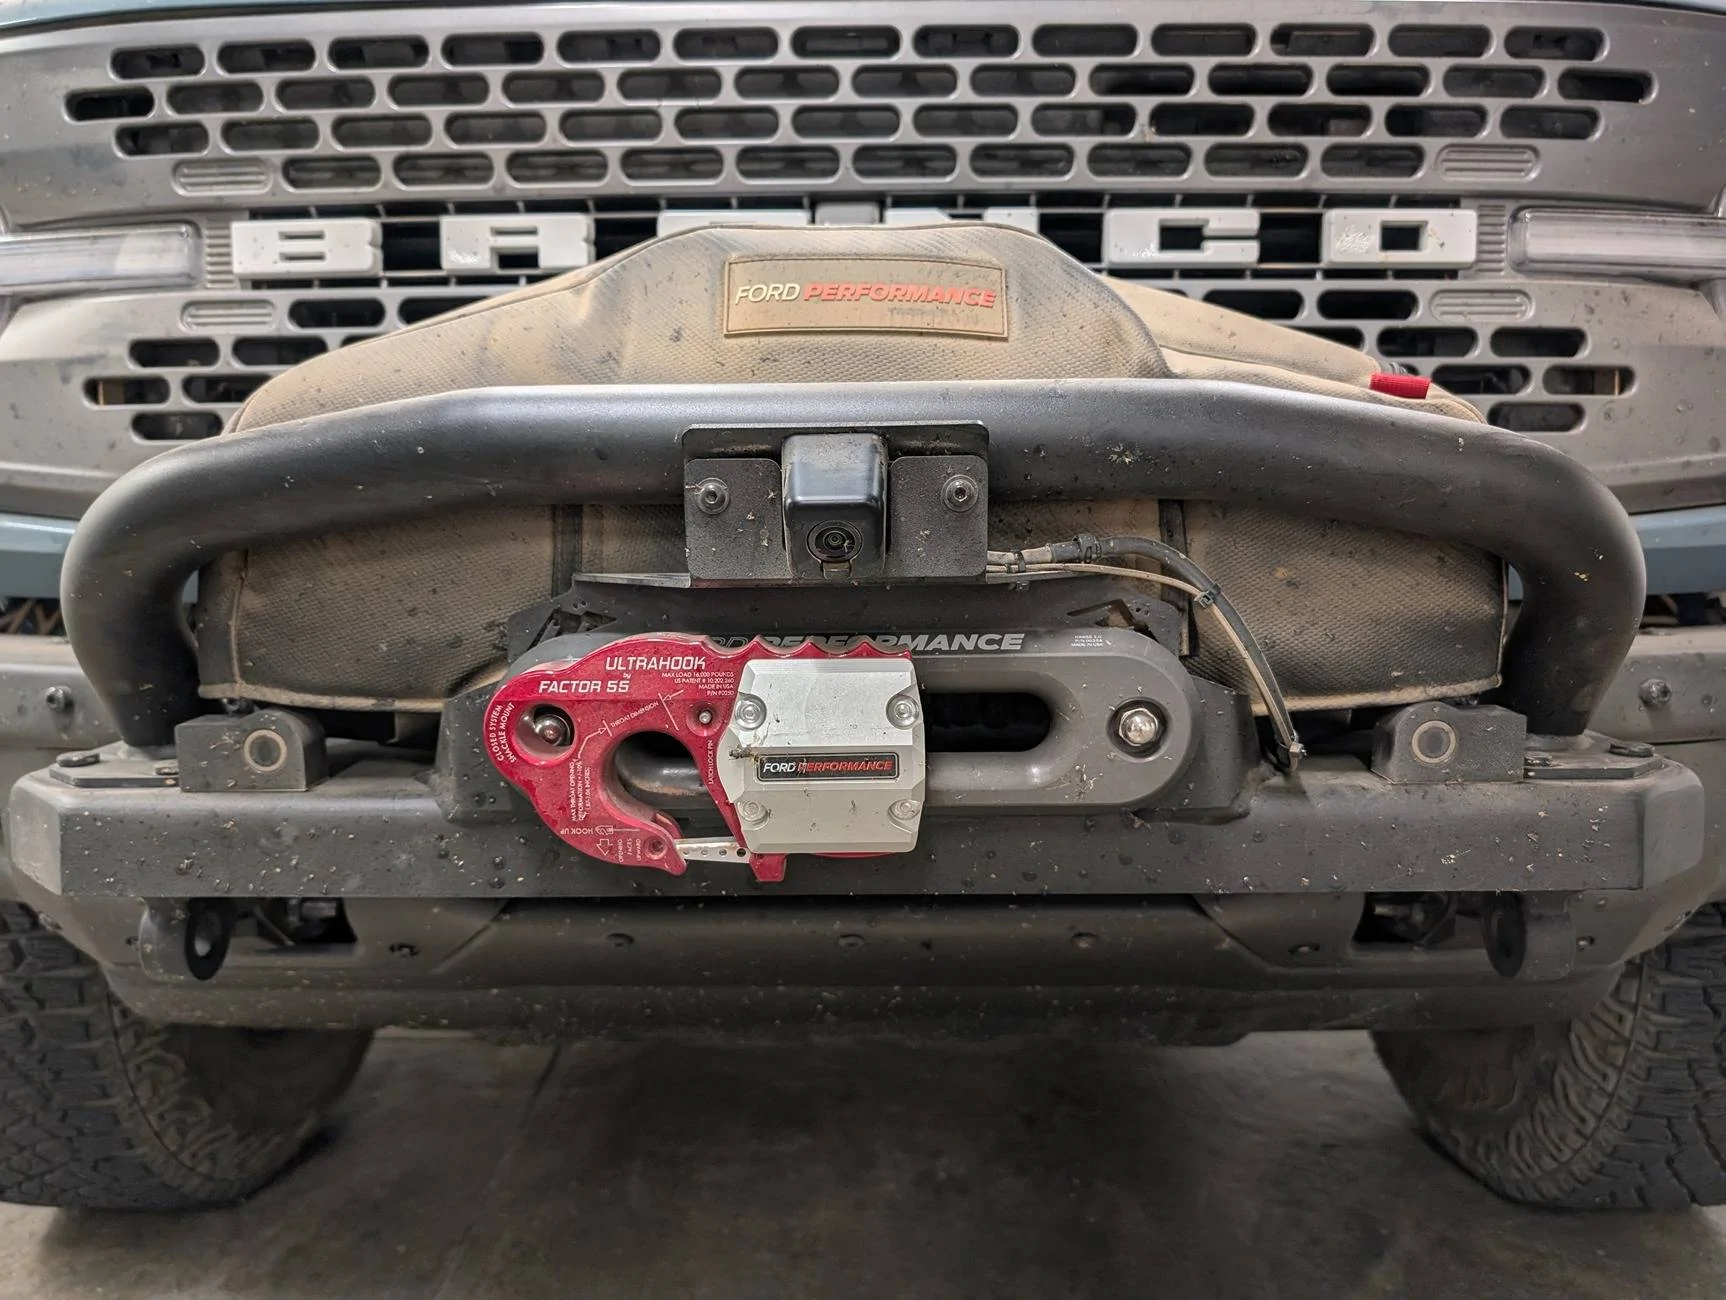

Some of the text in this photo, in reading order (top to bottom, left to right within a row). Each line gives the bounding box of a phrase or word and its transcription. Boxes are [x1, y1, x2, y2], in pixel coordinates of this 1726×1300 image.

[230, 207, 1478, 277] BRCO
[735, 282, 997, 307] FORD PERFORMANCE
[605, 656, 706, 670] ULTRAHOOK
[538, 680, 630, 693] FACTOR 55
[610, 700, 659, 728] THROAT DIMENSION
[489, 704, 505, 761] CLOSED SYSTEM
[498, 702, 517, 763] SHACKLE MOUNT
[763, 760, 893, 773] FORD PERFORMANCE
[560, 827, 594, 835] HOOK UP
